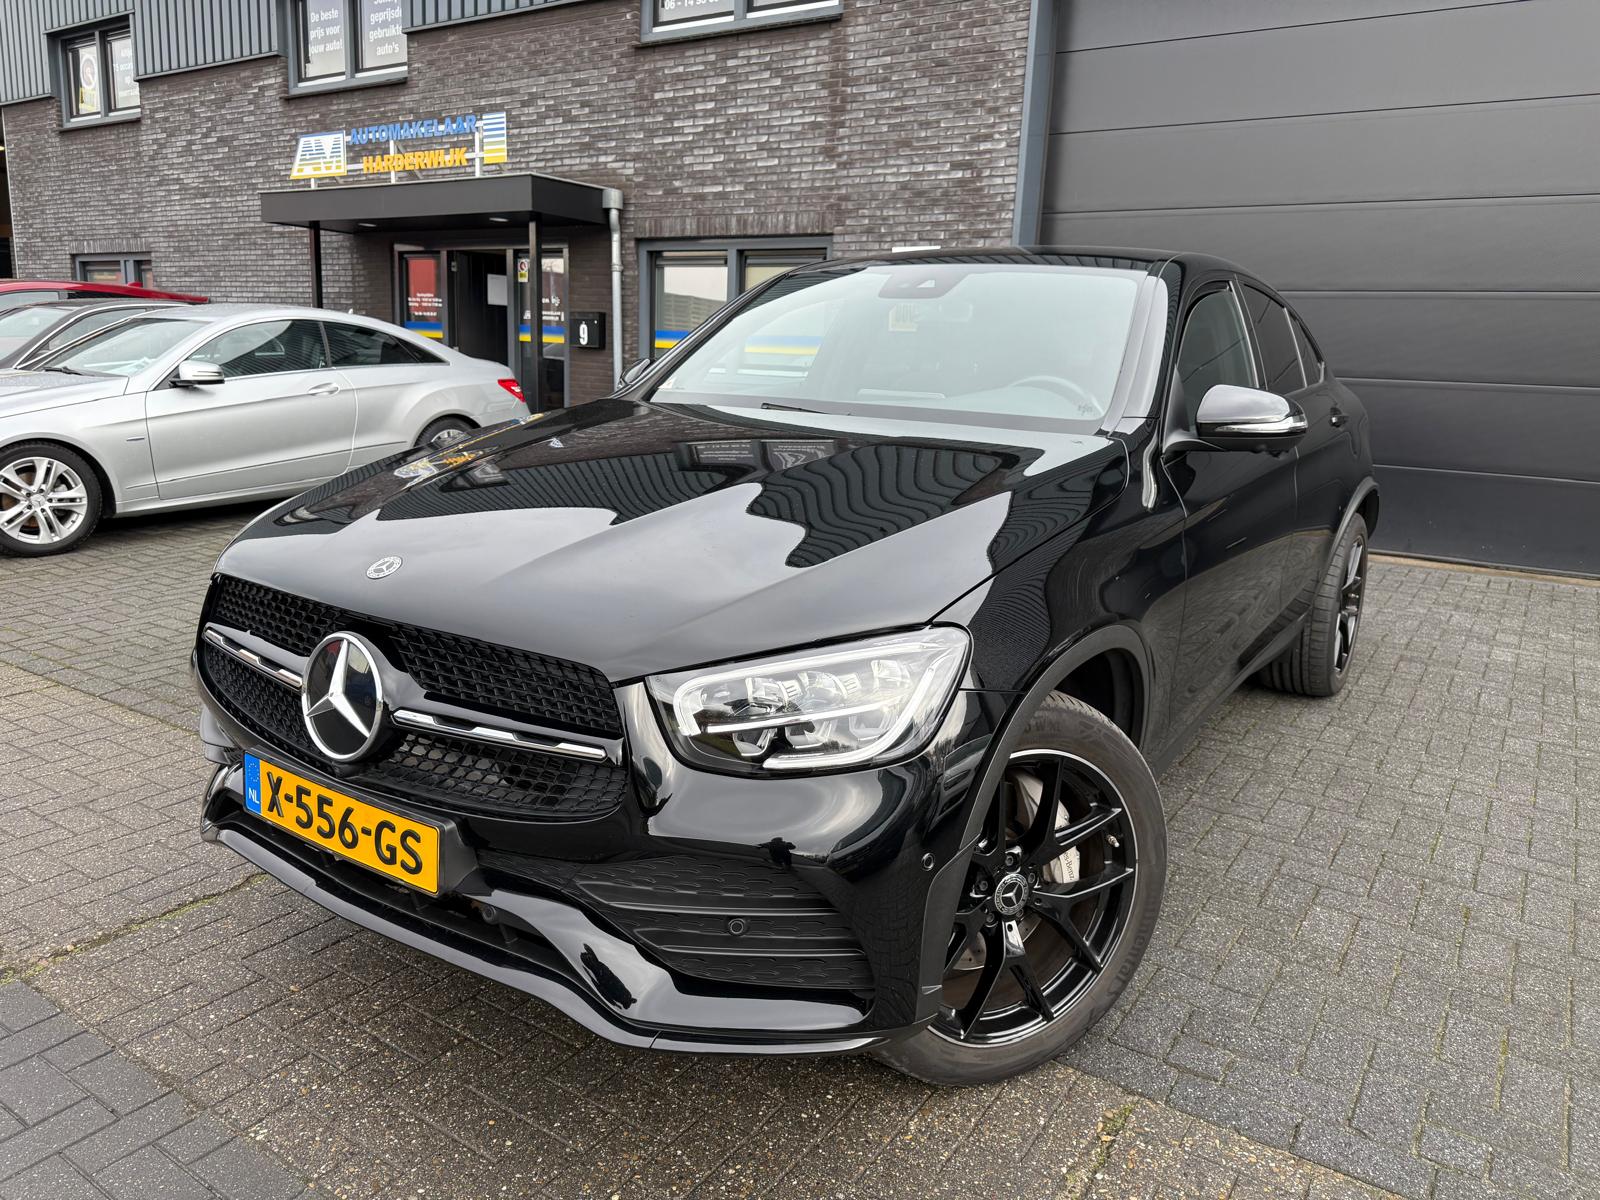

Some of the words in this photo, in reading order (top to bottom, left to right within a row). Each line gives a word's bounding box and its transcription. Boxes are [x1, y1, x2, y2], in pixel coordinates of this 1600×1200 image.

[310, 11, 320, 23] De
[320, 8, 339, 21] beste
[309, 26, 325, 40] prijs
[325, 24, 341, 36] voor
[325, 38, 343, 52] auto!
[376, 41, 400, 56] auto's
[349, 114, 478, 145] AUTOMAKELAAR
[362, 147, 468, 174] HARDERWIJK
[579, 323, 588, 345] 9
[248, 787, 260, 805] NL
[266, 771, 423, 875] X-556-GS
